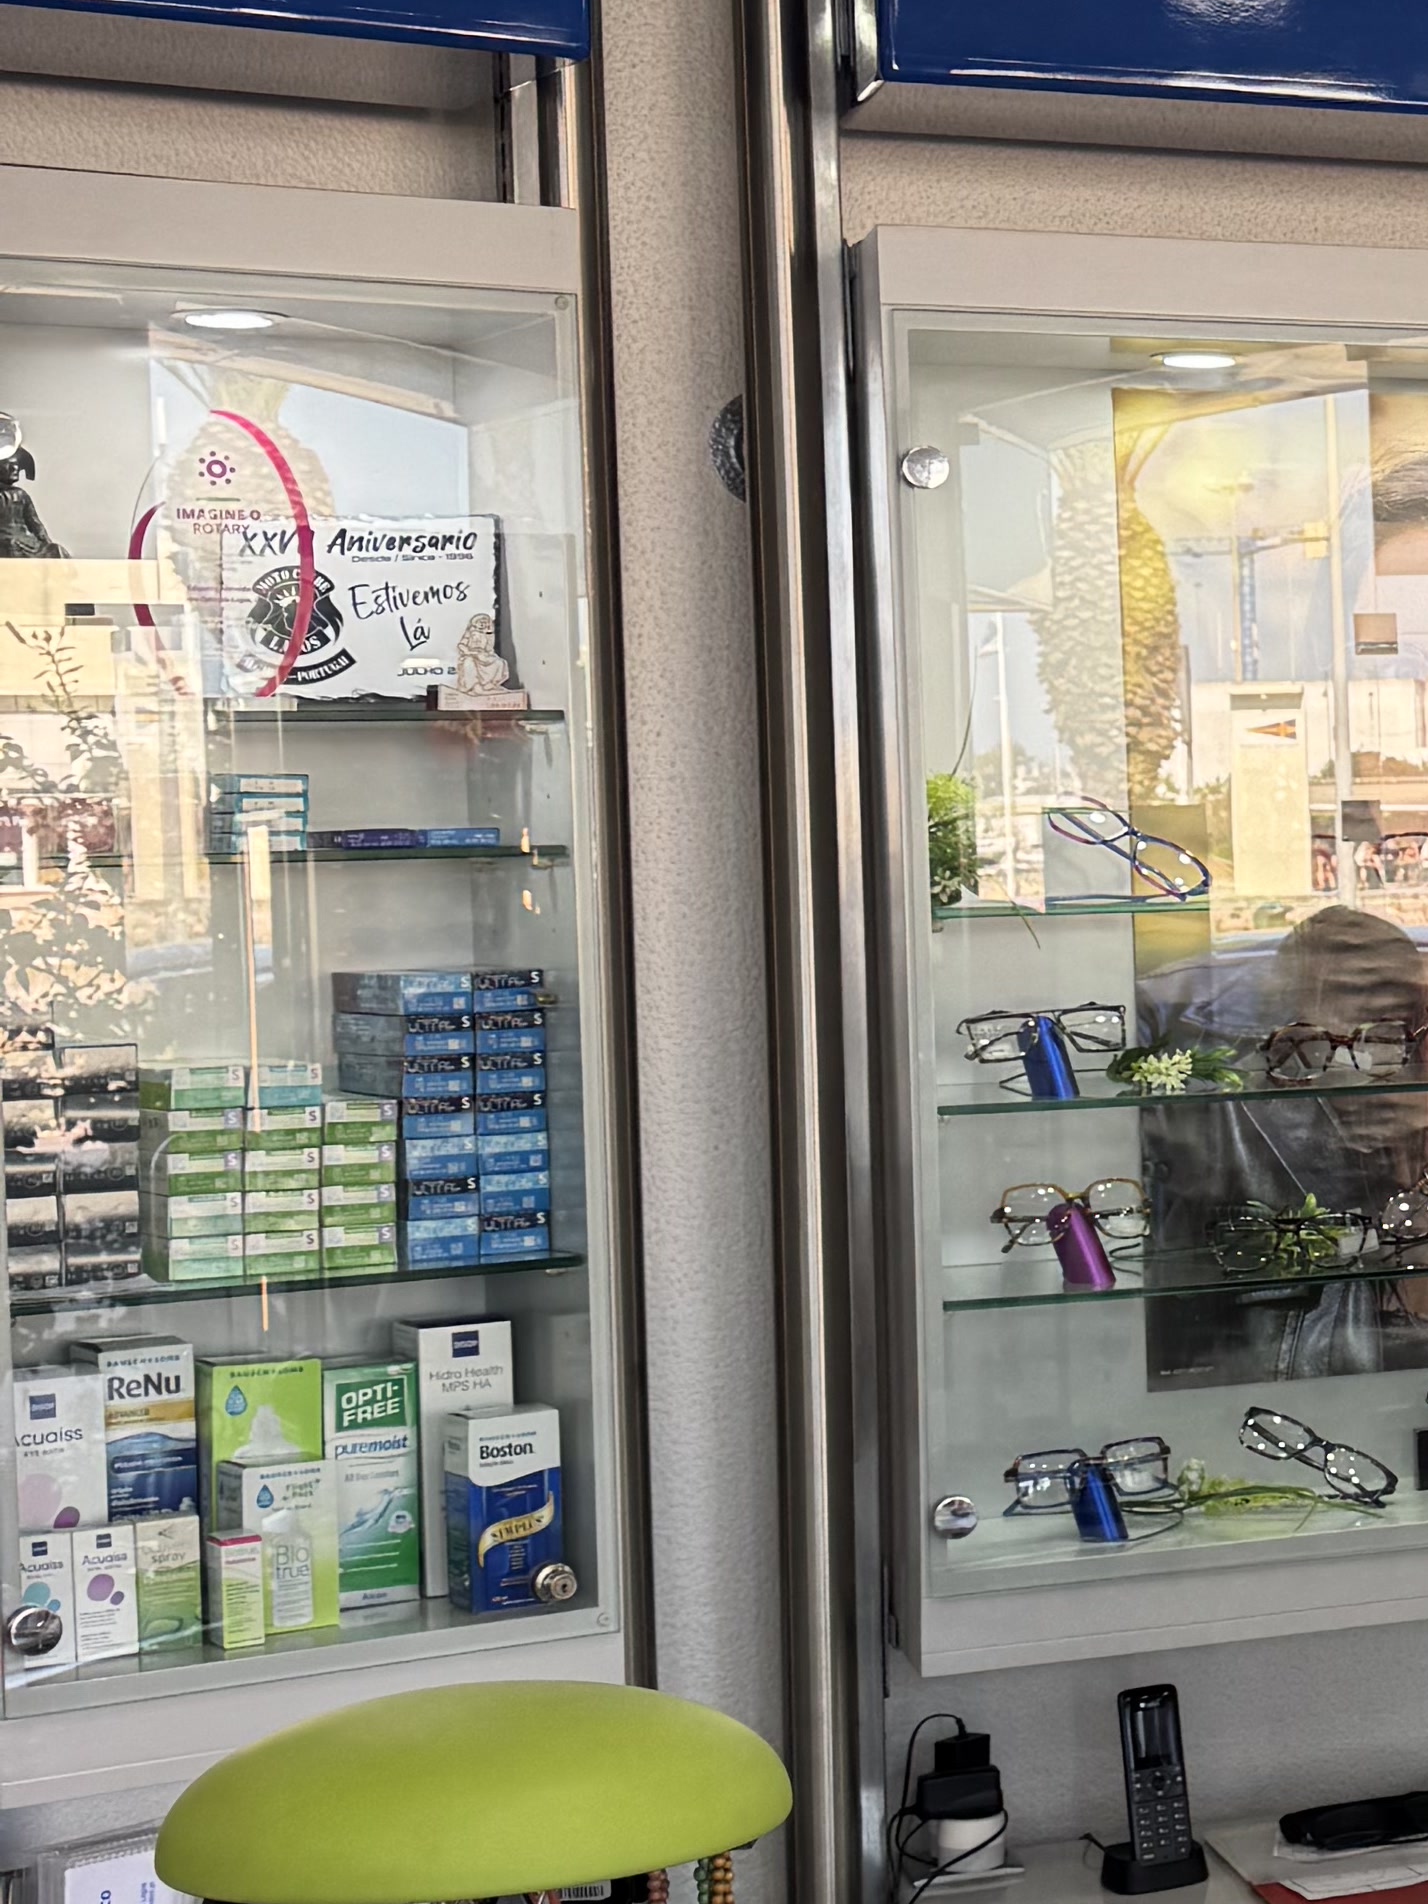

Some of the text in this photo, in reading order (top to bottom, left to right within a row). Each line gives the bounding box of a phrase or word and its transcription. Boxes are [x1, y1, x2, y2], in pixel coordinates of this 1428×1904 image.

[193, 523, 250, 535] ROTARY
[326, 528, 478, 556] Aniversario
[348, 580, 471, 621] Estivemos
[465, 1365, 504, 1378] Health
[107, 1372, 181, 1401] ReNu
[341, 1383, 399, 1409] OPTI-
[441, 1381, 470, 1393] MPS
[342, 1397, 400, 1427] FREE
[335, 1435, 408, 1460] puremoist
[479, 1440, 535, 1461] Boston
[151, 1551, 187, 1564] spray
[276, 1565, 310, 1579] true
